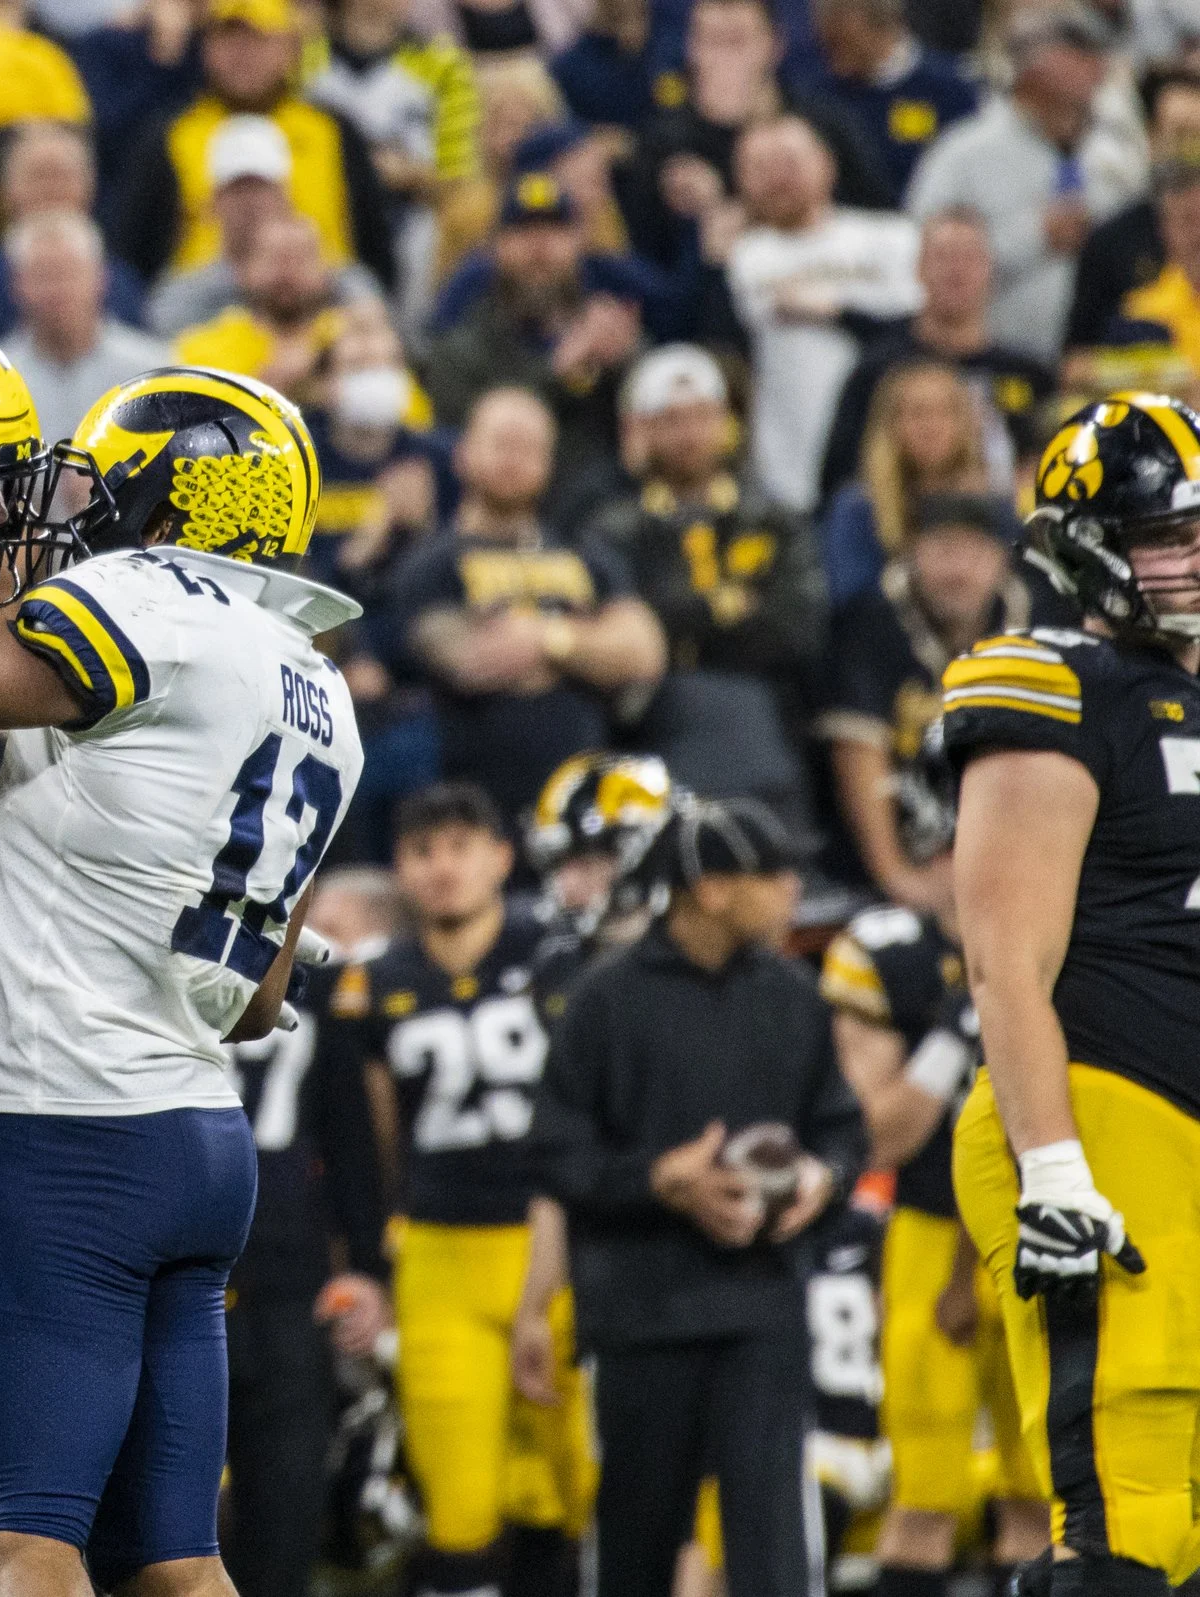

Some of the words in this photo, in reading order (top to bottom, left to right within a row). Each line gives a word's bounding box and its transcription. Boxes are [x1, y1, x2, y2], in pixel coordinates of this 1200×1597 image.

[16, 442, 32, 461] M
[261, 539, 280, 558] 12
[279, 663, 334, 748] ROSS
[170, 731, 343, 985] 12
[386, 995, 549, 1152] 29
